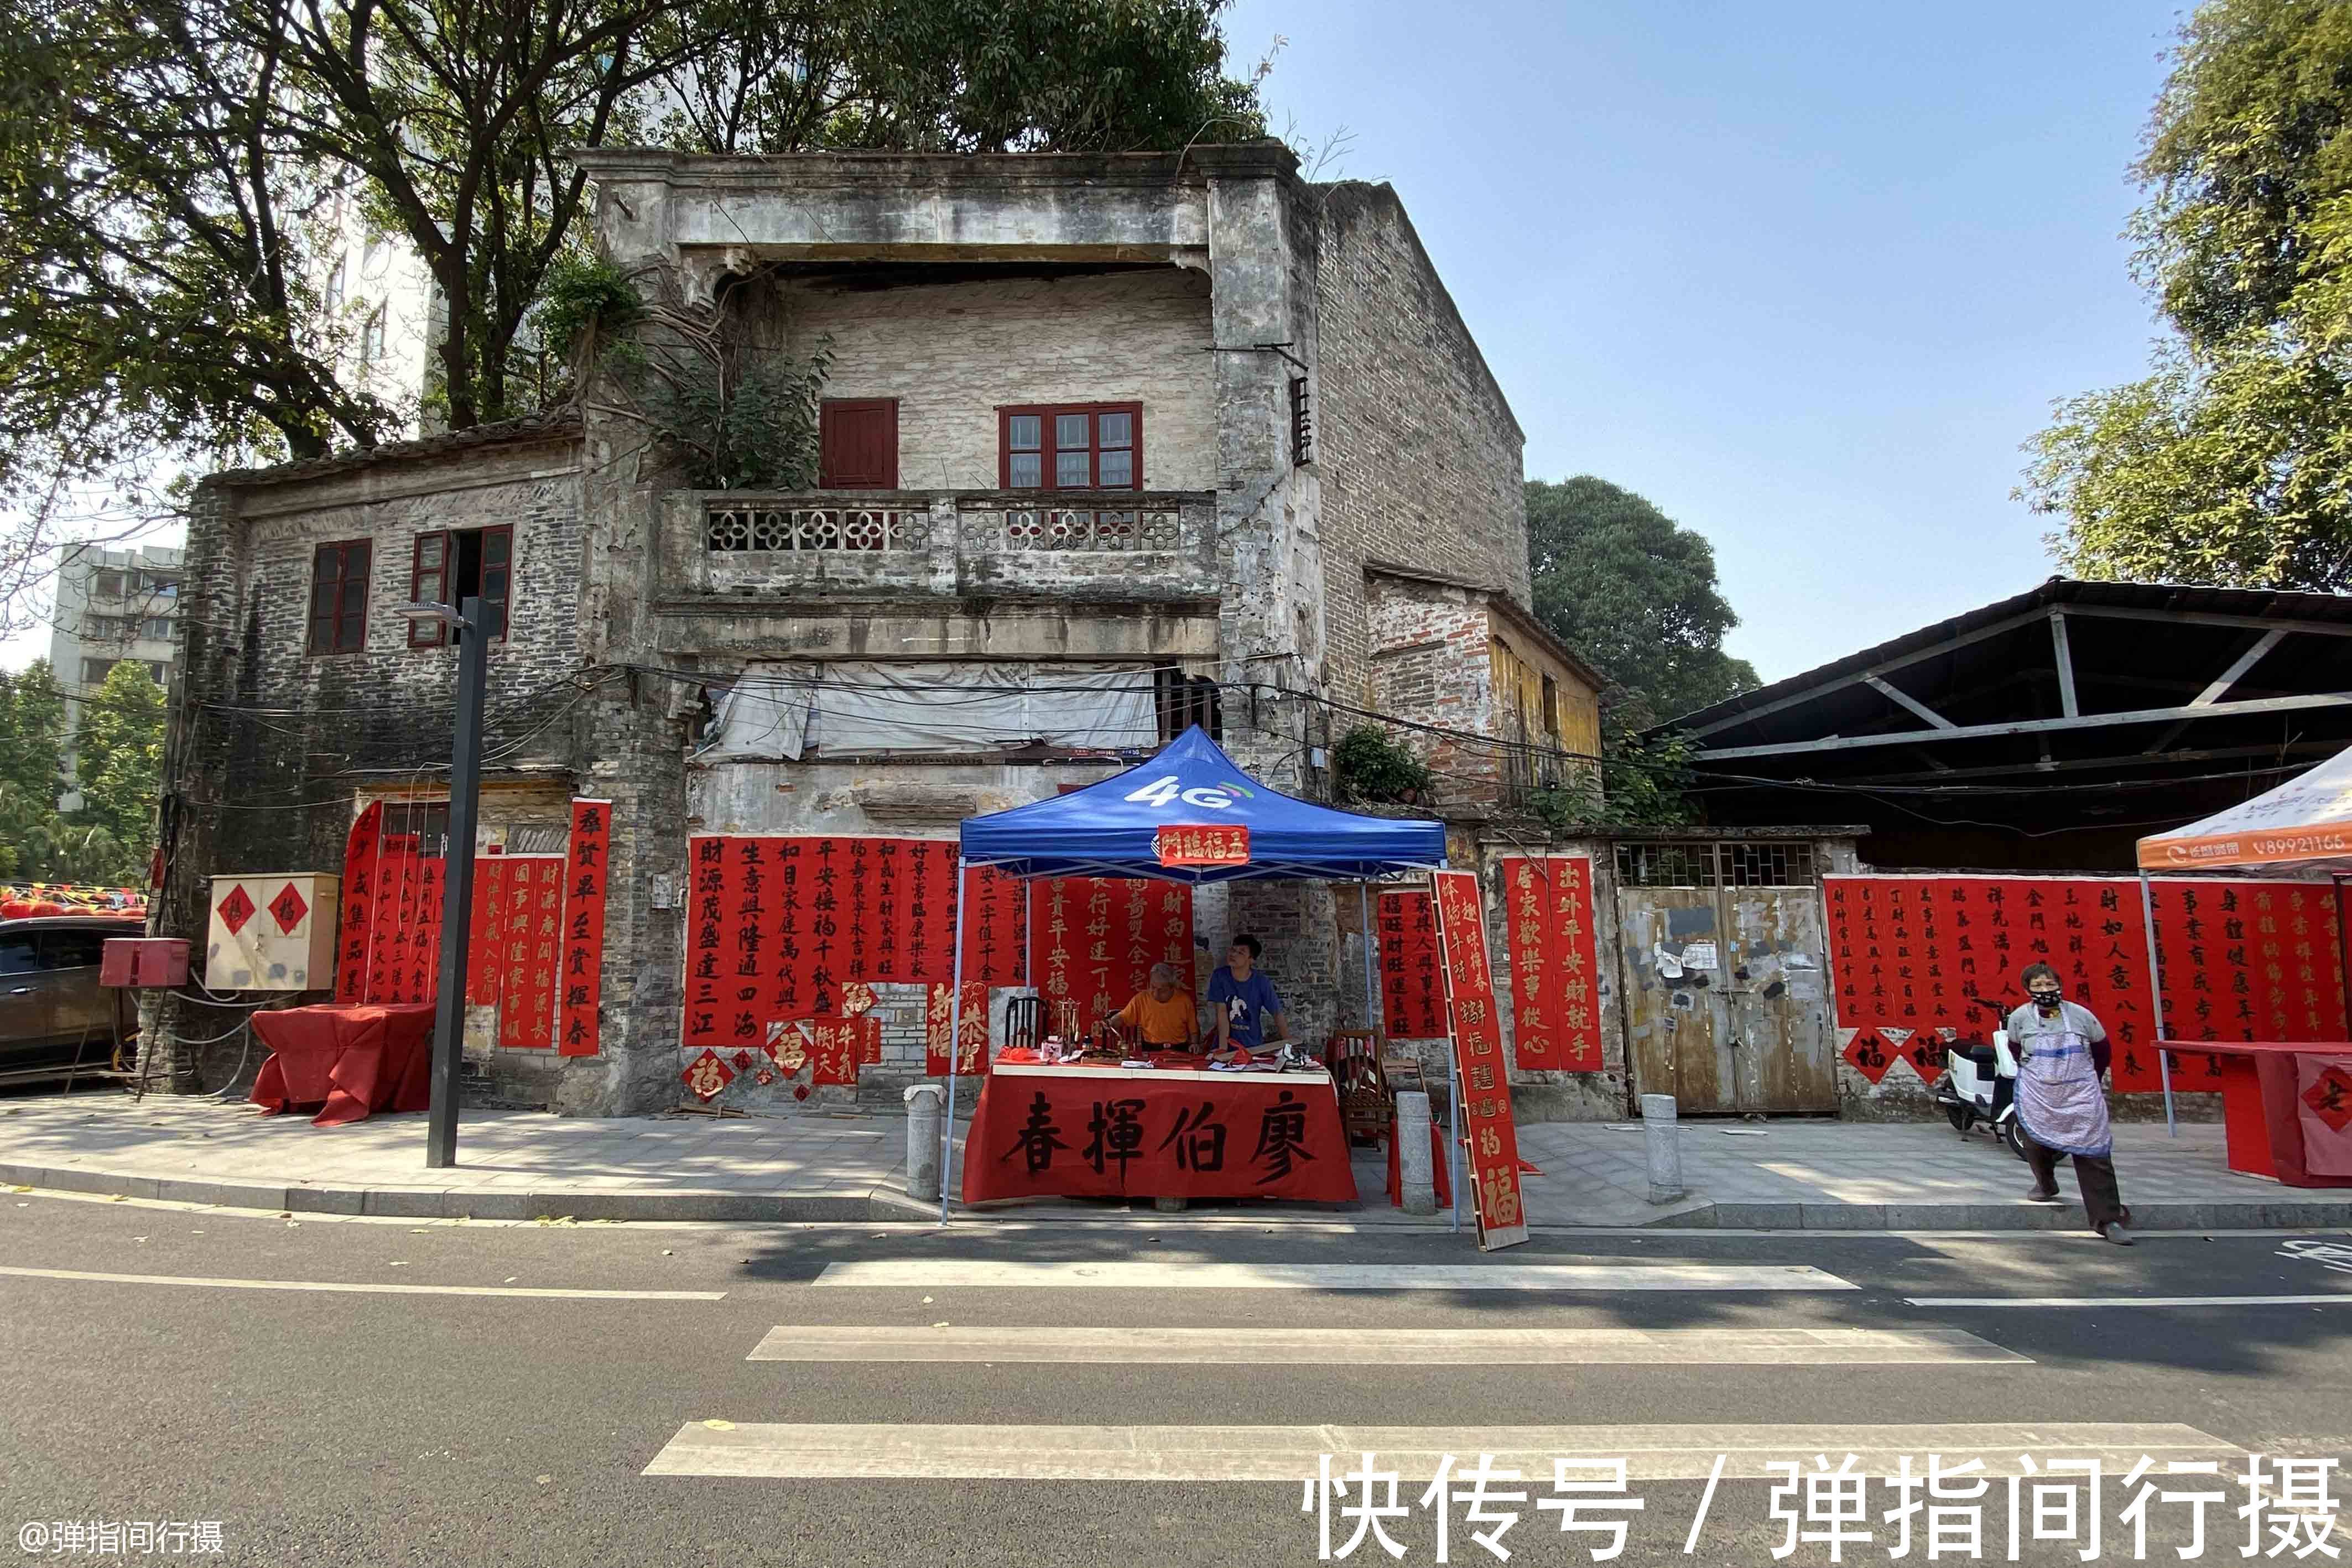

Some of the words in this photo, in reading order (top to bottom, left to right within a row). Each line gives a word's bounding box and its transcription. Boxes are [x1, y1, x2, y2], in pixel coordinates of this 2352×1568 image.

[1124, 775, 1232, 809] 4G
[2267, 835, 2345, 854] 89921166
[734, 840, 767, 1039] 生意興隆通四海
[845, 983, 872, 1013] 福
[774, 1032, 806, 1071] 福
[1856, 1035, 1886, 1068] 福
[690, 1058, 724, 1097] 福
[1484, 1164, 1520, 1226] 福
